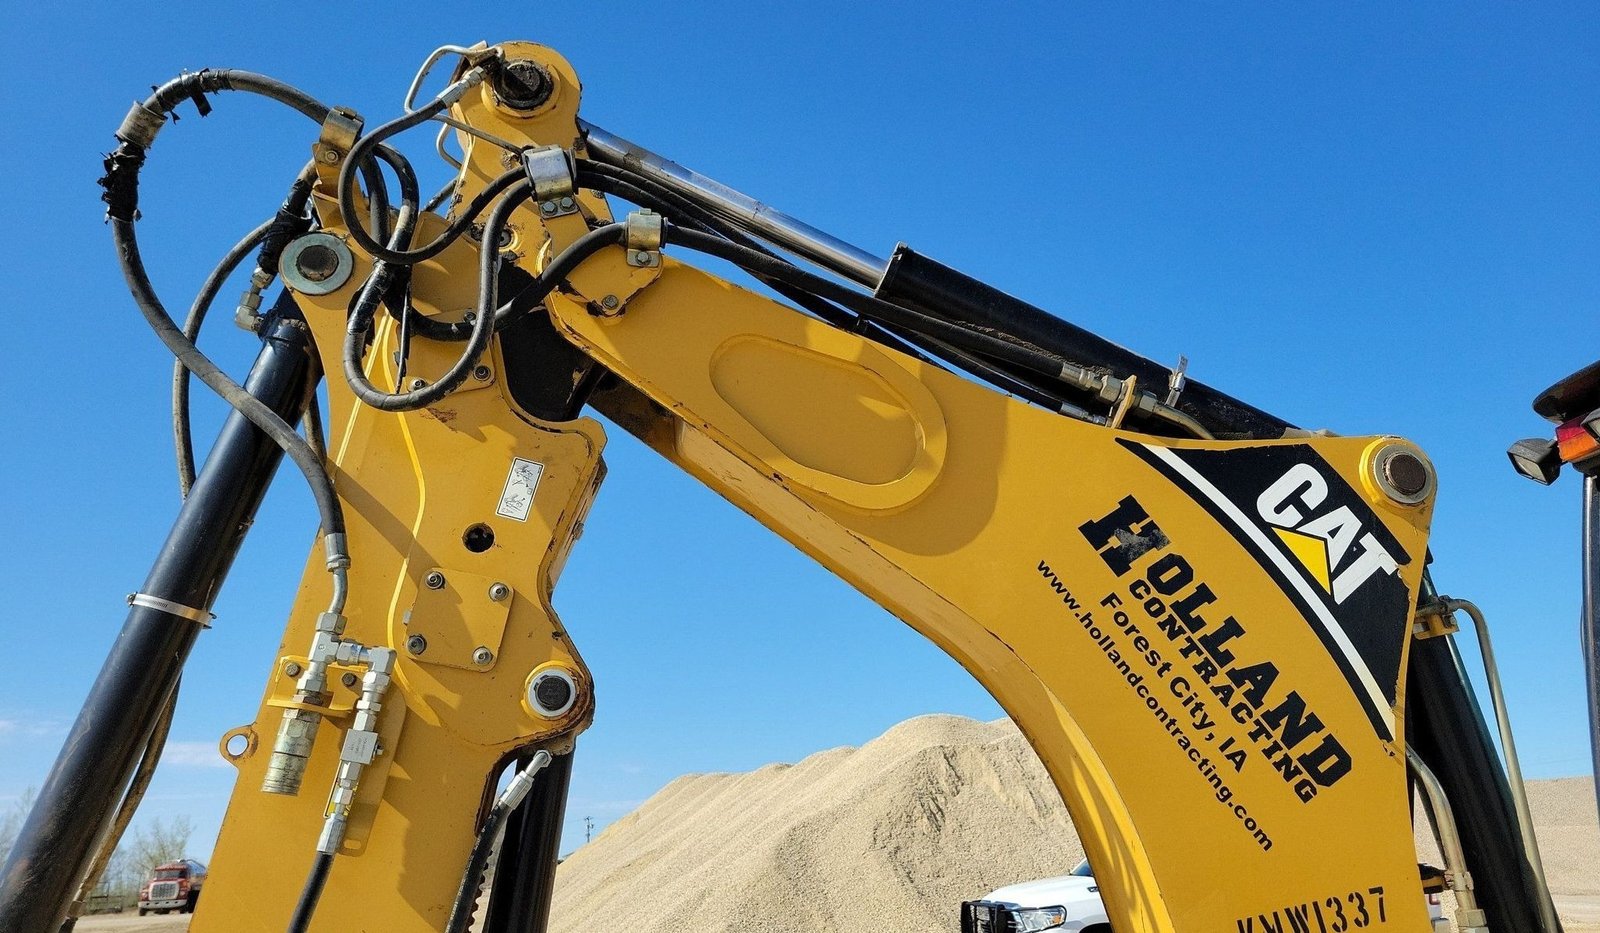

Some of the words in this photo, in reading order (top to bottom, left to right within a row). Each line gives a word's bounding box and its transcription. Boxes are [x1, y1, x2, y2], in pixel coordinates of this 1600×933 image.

[1078, 494, 1352, 788] HOLLAND
[1257, 463, 1399, 605] CAT
[1037, 560, 1273, 852] www.hollandcontracting.com
[1100, 591, 1173, 679] Forest
[1169, 676, 1216, 742] City,
[1218, 736, 1248, 773] IA
[1129, 578, 1318, 804] CONTRACTING
